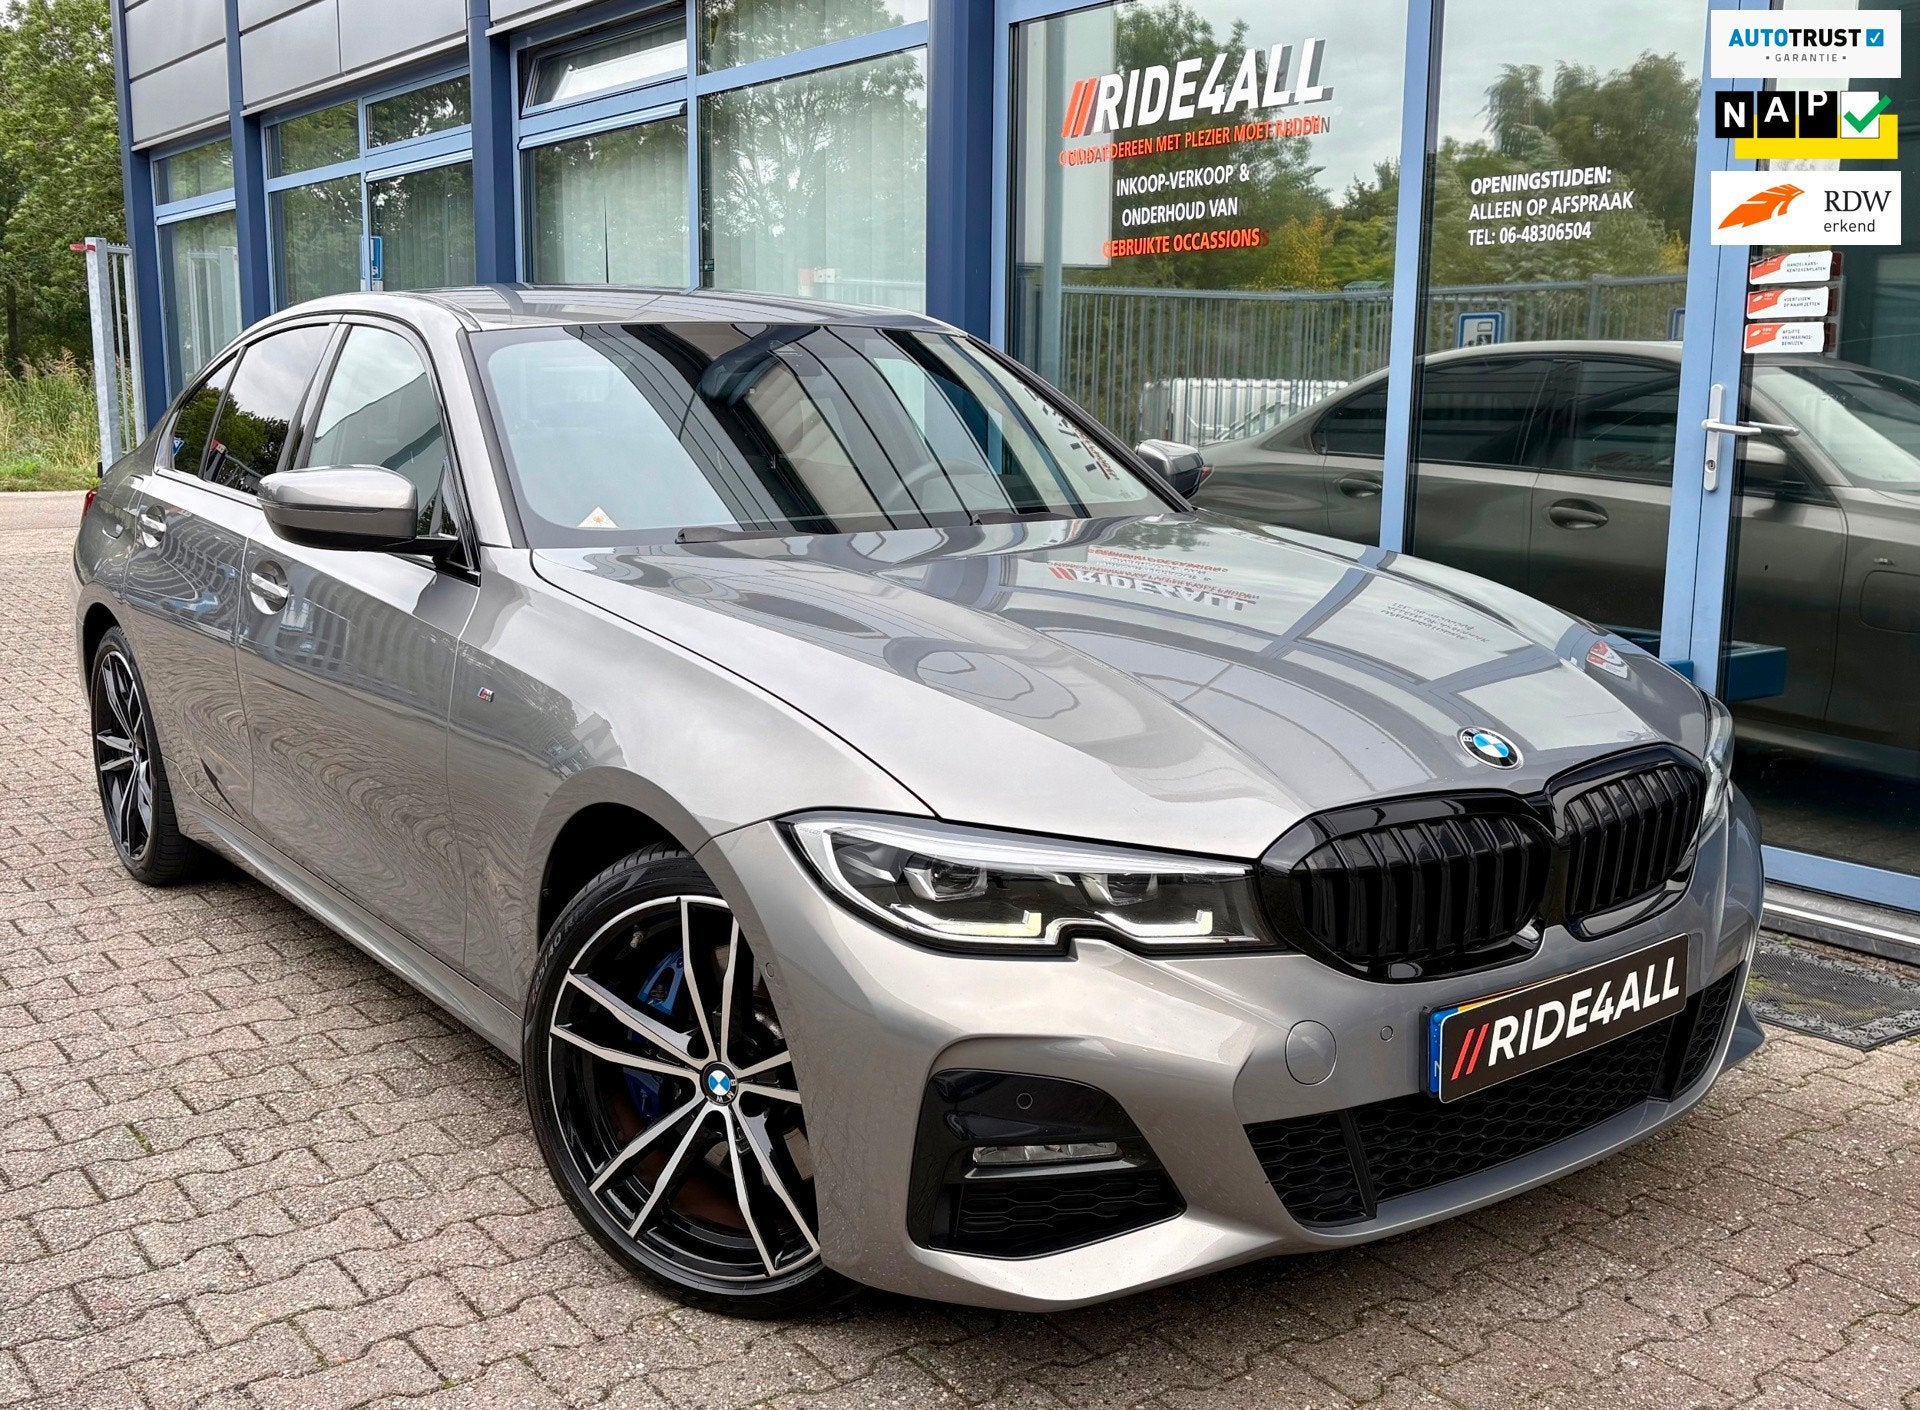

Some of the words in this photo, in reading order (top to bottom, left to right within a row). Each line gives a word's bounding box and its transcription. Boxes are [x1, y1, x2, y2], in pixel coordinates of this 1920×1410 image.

[1156, 133, 1182, 153] MET
[1185, 126, 1230, 149] PLEZIER
[1234, 122, 1271, 142] MOET
[1116, 164, 1234, 196] INKOOP-VERKOOP
[1239, 163, 1250, 183] &
[1470, 166, 1612, 195] OPENINGSTIJDEN:
[1122, 201, 1206, 227] ONDERHOUD
[1209, 197, 1238, 218] VAN
[1469, 200, 1522, 221] ALLEEN
[1526, 198, 1547, 217] OP
[1550, 190, 1635, 214] AFSPRAAK
[1102, 235, 1170, 259] GEBRUIKTE
[1173, 227, 1260, 252] OCCASSIONS
[1468, 229, 1496, 246] TEL:
[1499, 222, 1592, 244] 06-48306504
